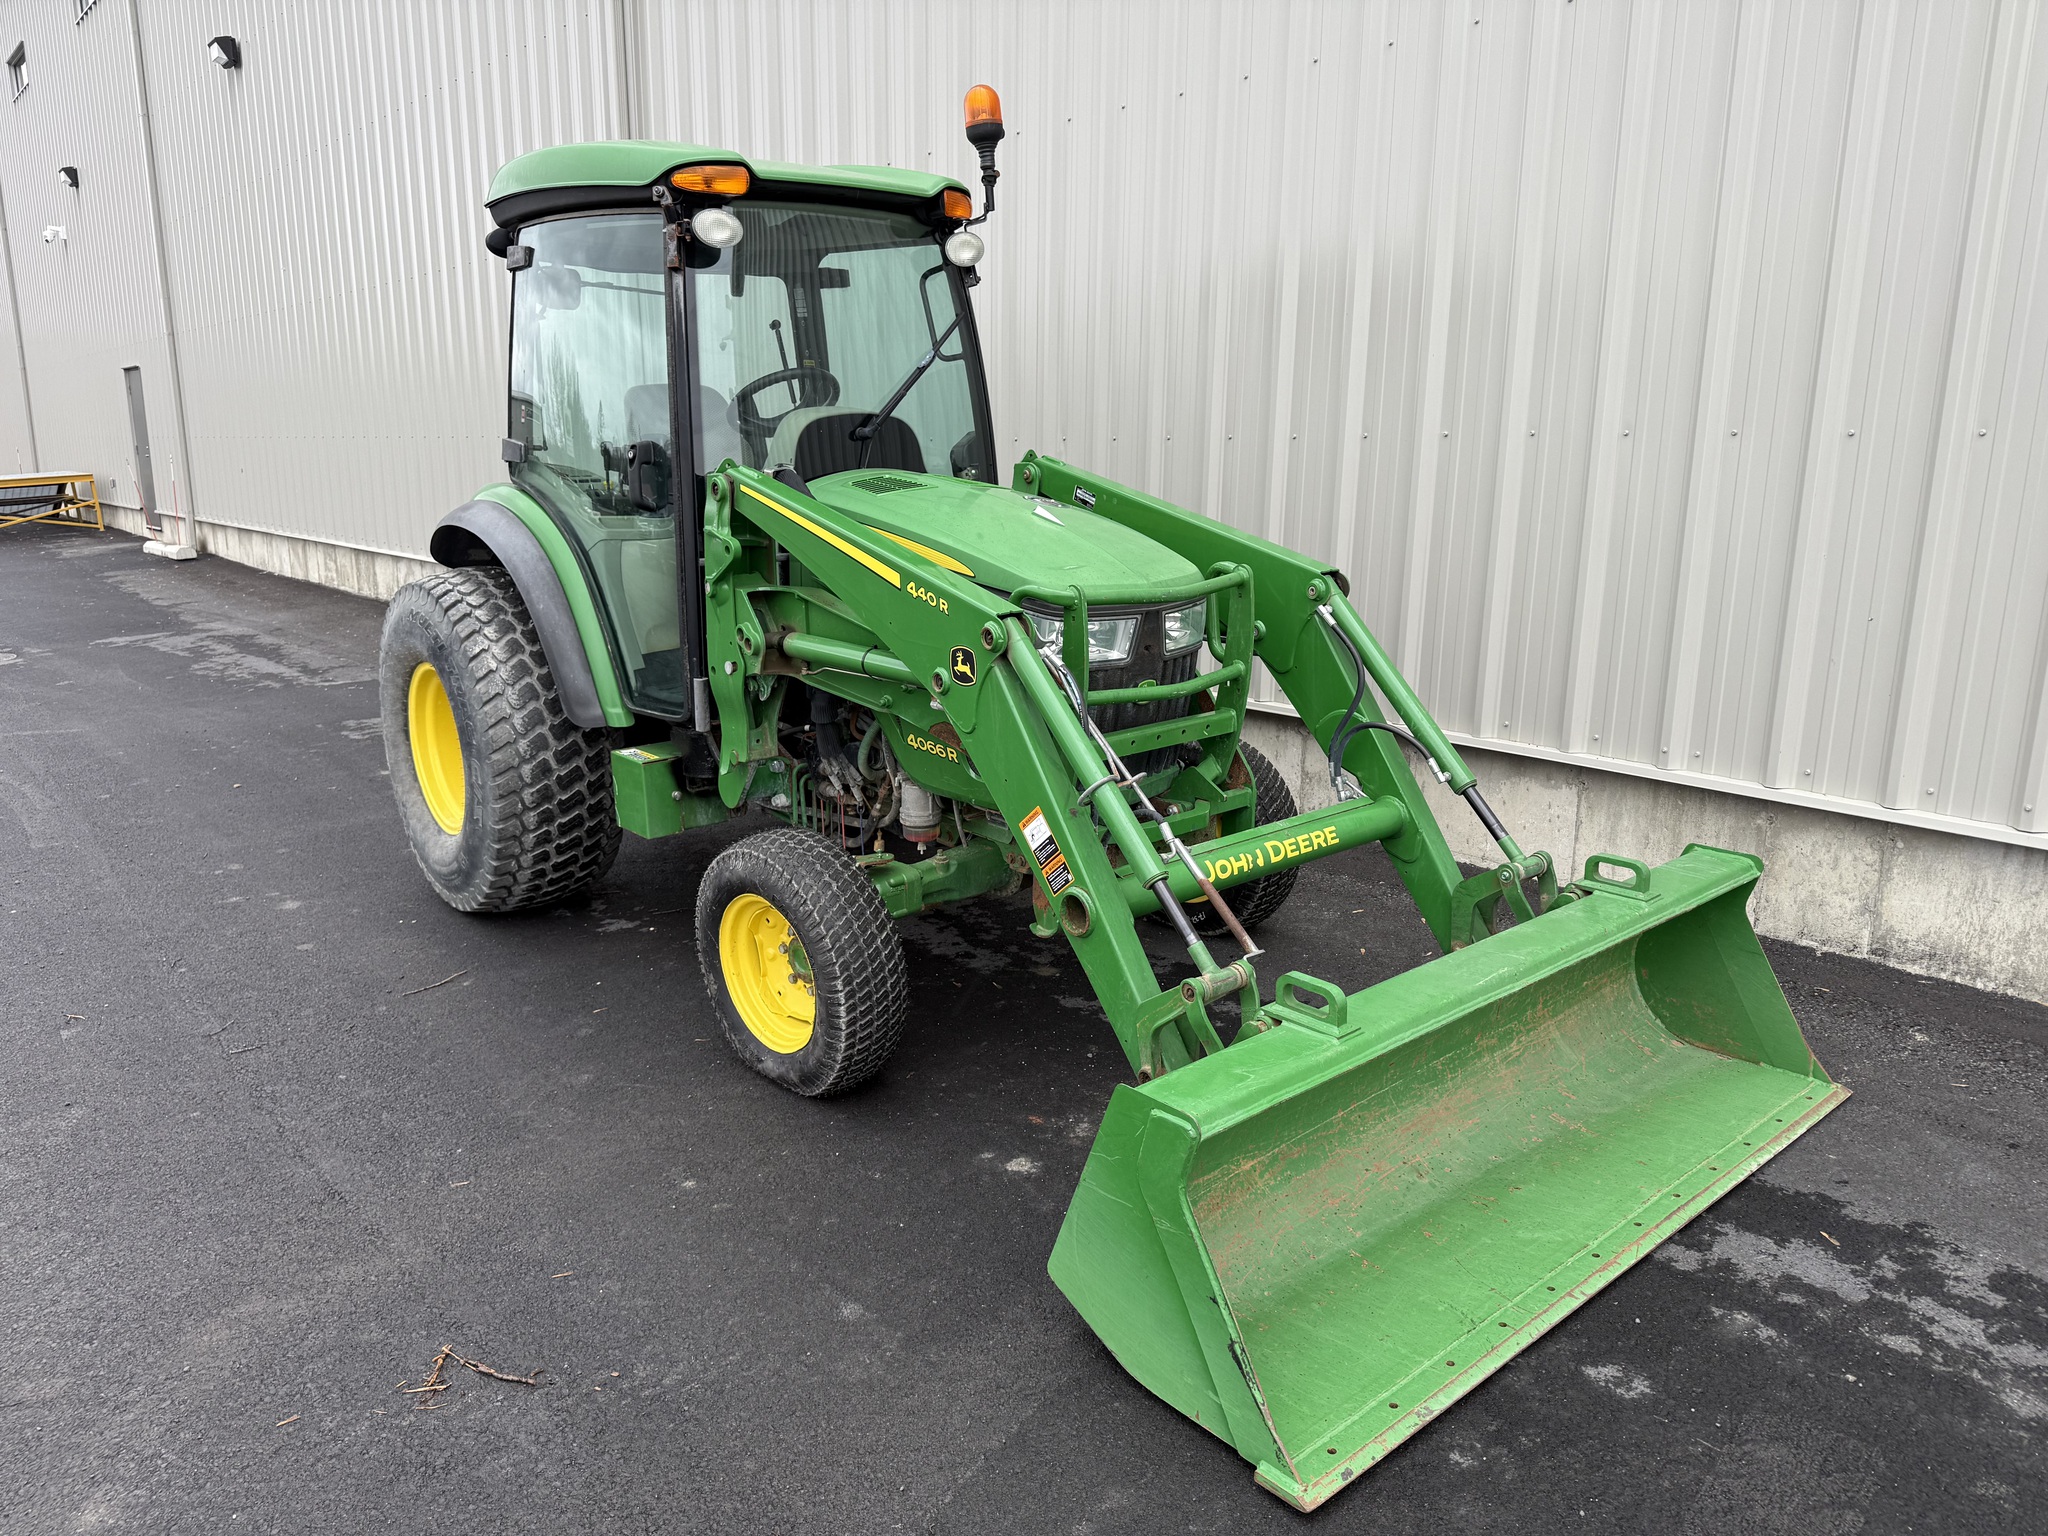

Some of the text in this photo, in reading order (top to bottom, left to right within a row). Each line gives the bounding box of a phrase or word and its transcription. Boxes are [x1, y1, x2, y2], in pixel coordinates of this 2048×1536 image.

[907, 581, 949, 615] 440 R
[1263, 825, 1340, 864] DEERE
